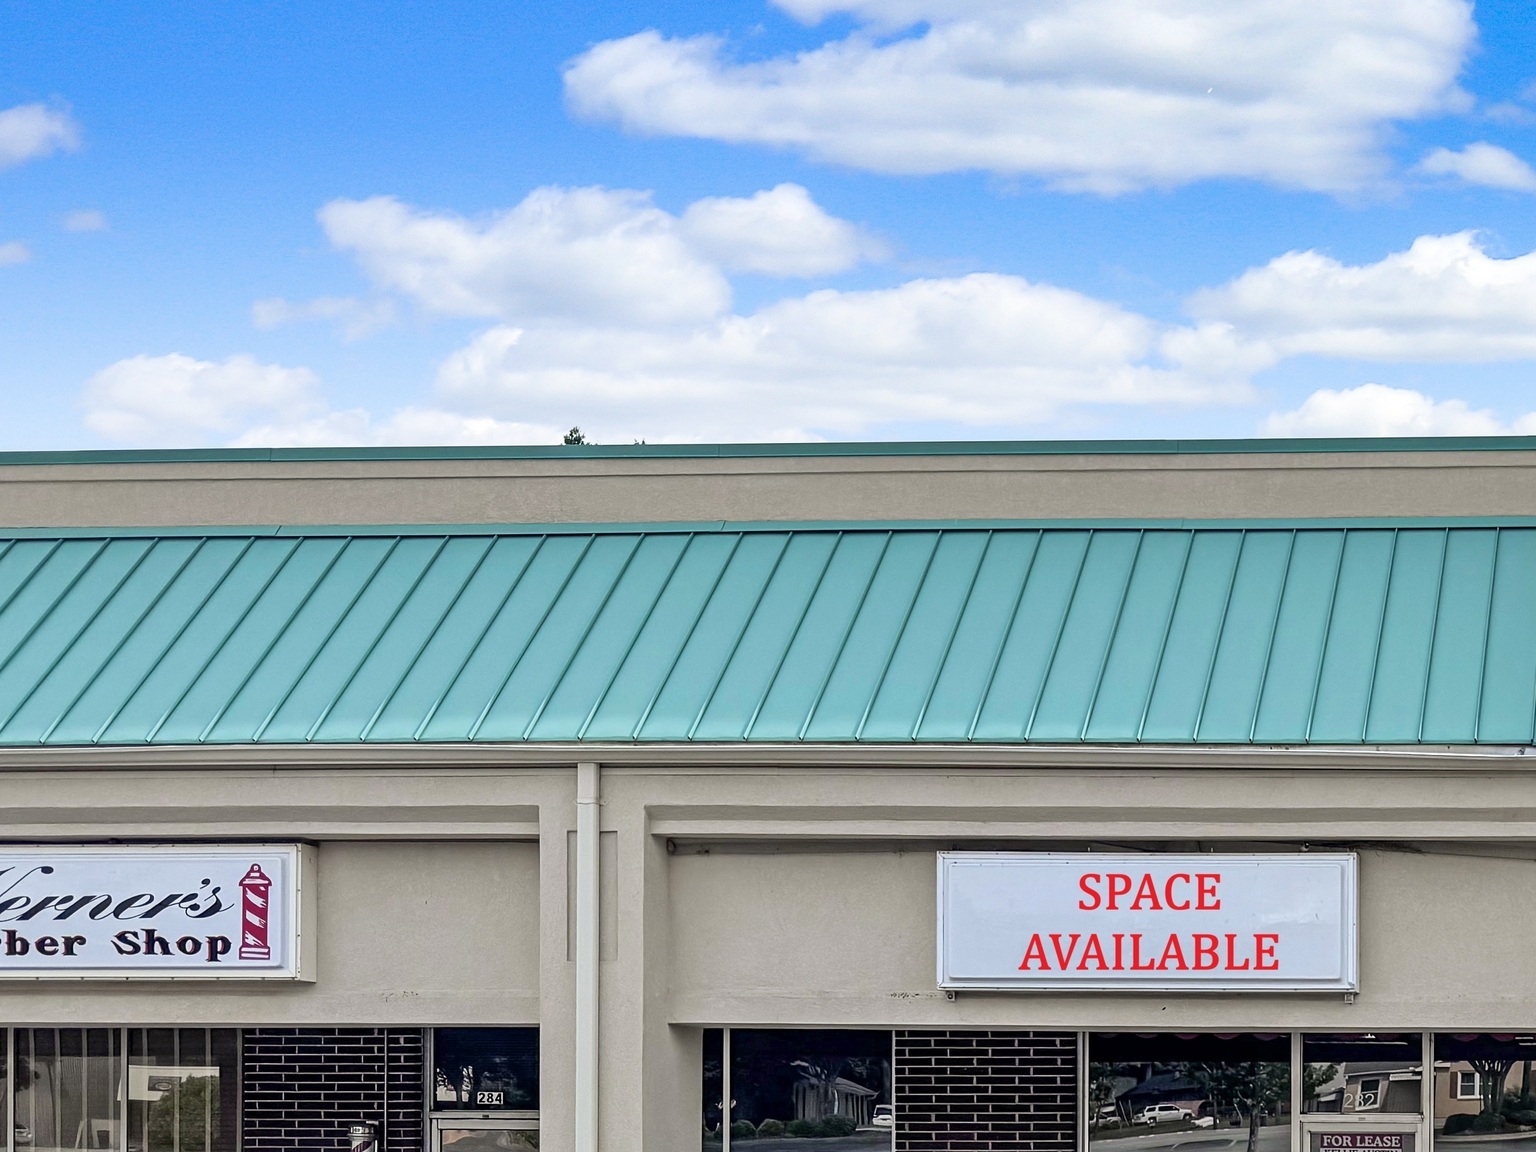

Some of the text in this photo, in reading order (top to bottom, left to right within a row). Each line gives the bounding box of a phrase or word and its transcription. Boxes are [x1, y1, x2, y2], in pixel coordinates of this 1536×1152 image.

[1078, 873, 1222, 911] SPACE
[0, 928, 233, 963] ber Shop
[1018, 933, 1280, 971] AVAILABLE
[478, 1092, 502, 1104] 284
[1344, 1093, 1376, 1108] 282
[1323, 1135, 1401, 1147] FOR LEASE
